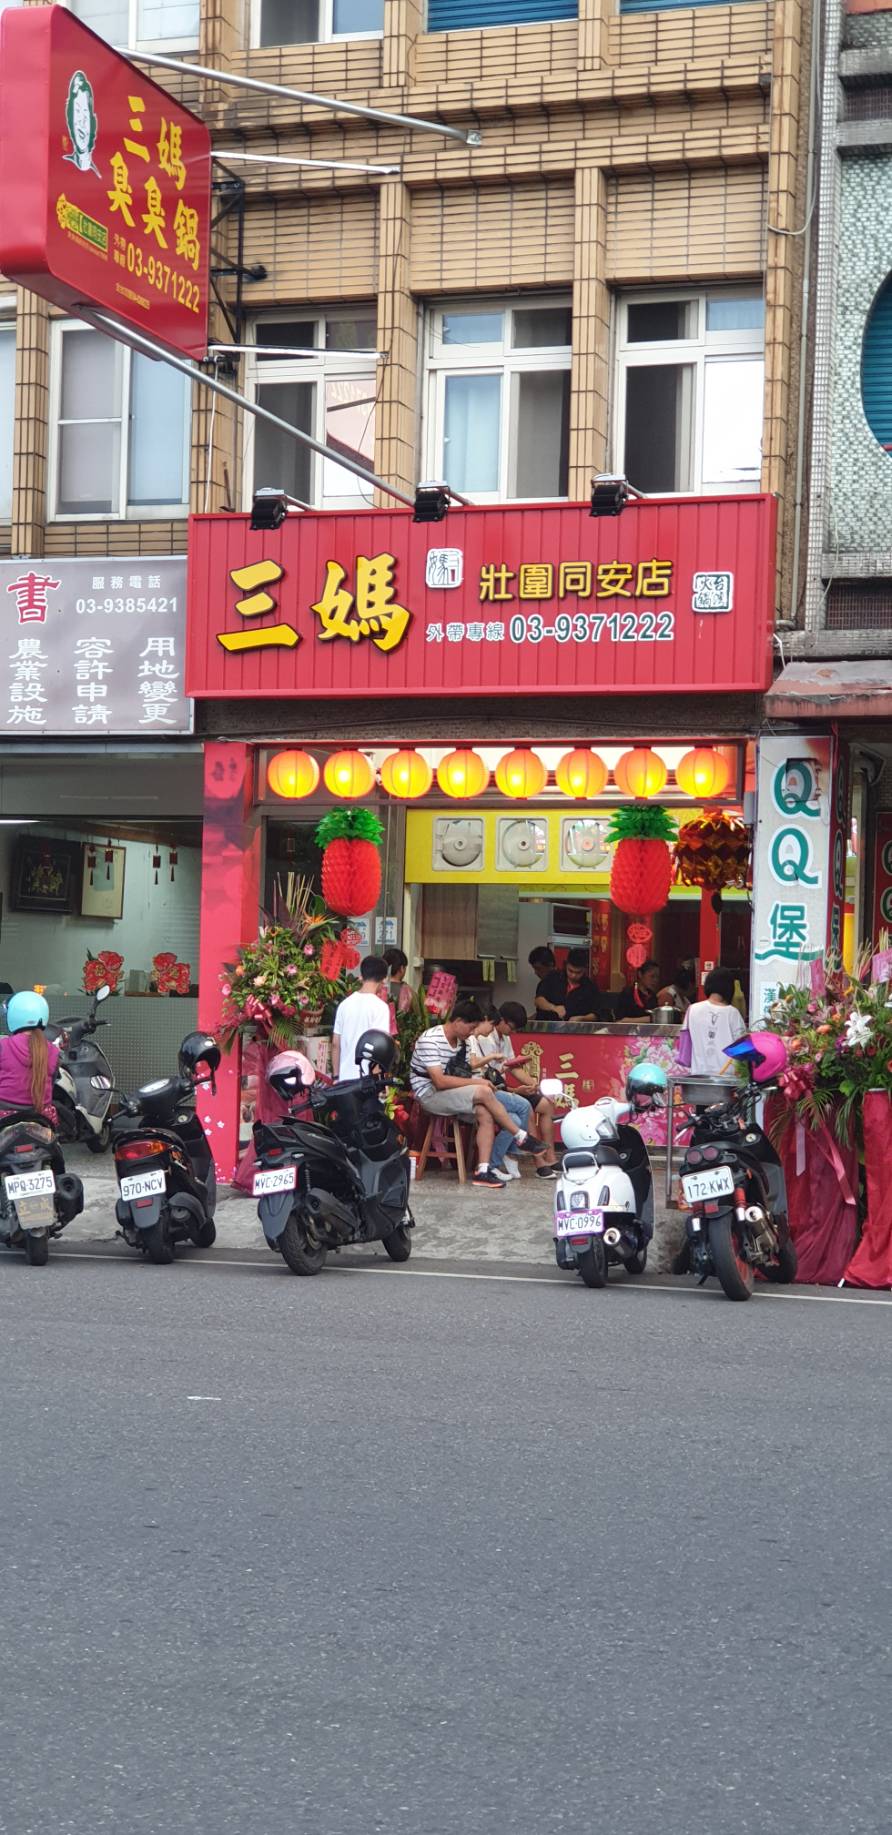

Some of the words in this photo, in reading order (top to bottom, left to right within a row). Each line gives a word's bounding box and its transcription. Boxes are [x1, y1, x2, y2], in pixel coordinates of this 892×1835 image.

[123, 96, 186, 191] 三媽
[127, 243, 200, 313] 03-9371222
[7, 571, 62, 625] 書
[92, 575, 161, 589] 服務電話
[216, 552, 411, 653] 三媽
[479, 559, 673, 601] 壯圍同安店
[75, 597, 177, 614] 03-9385421
[509, 612, 674, 643] 03-9371222
[426, 622, 505, 642] 外帶專線
[6, 638, 48, 724] 農業設施
[72, 636, 115, 725] 容許申請
[137, 637, 180, 724] 用地變更
[123, 1179, 163, 1197] 970-NCV
[687, 1176, 731, 1198] 172-KWX
